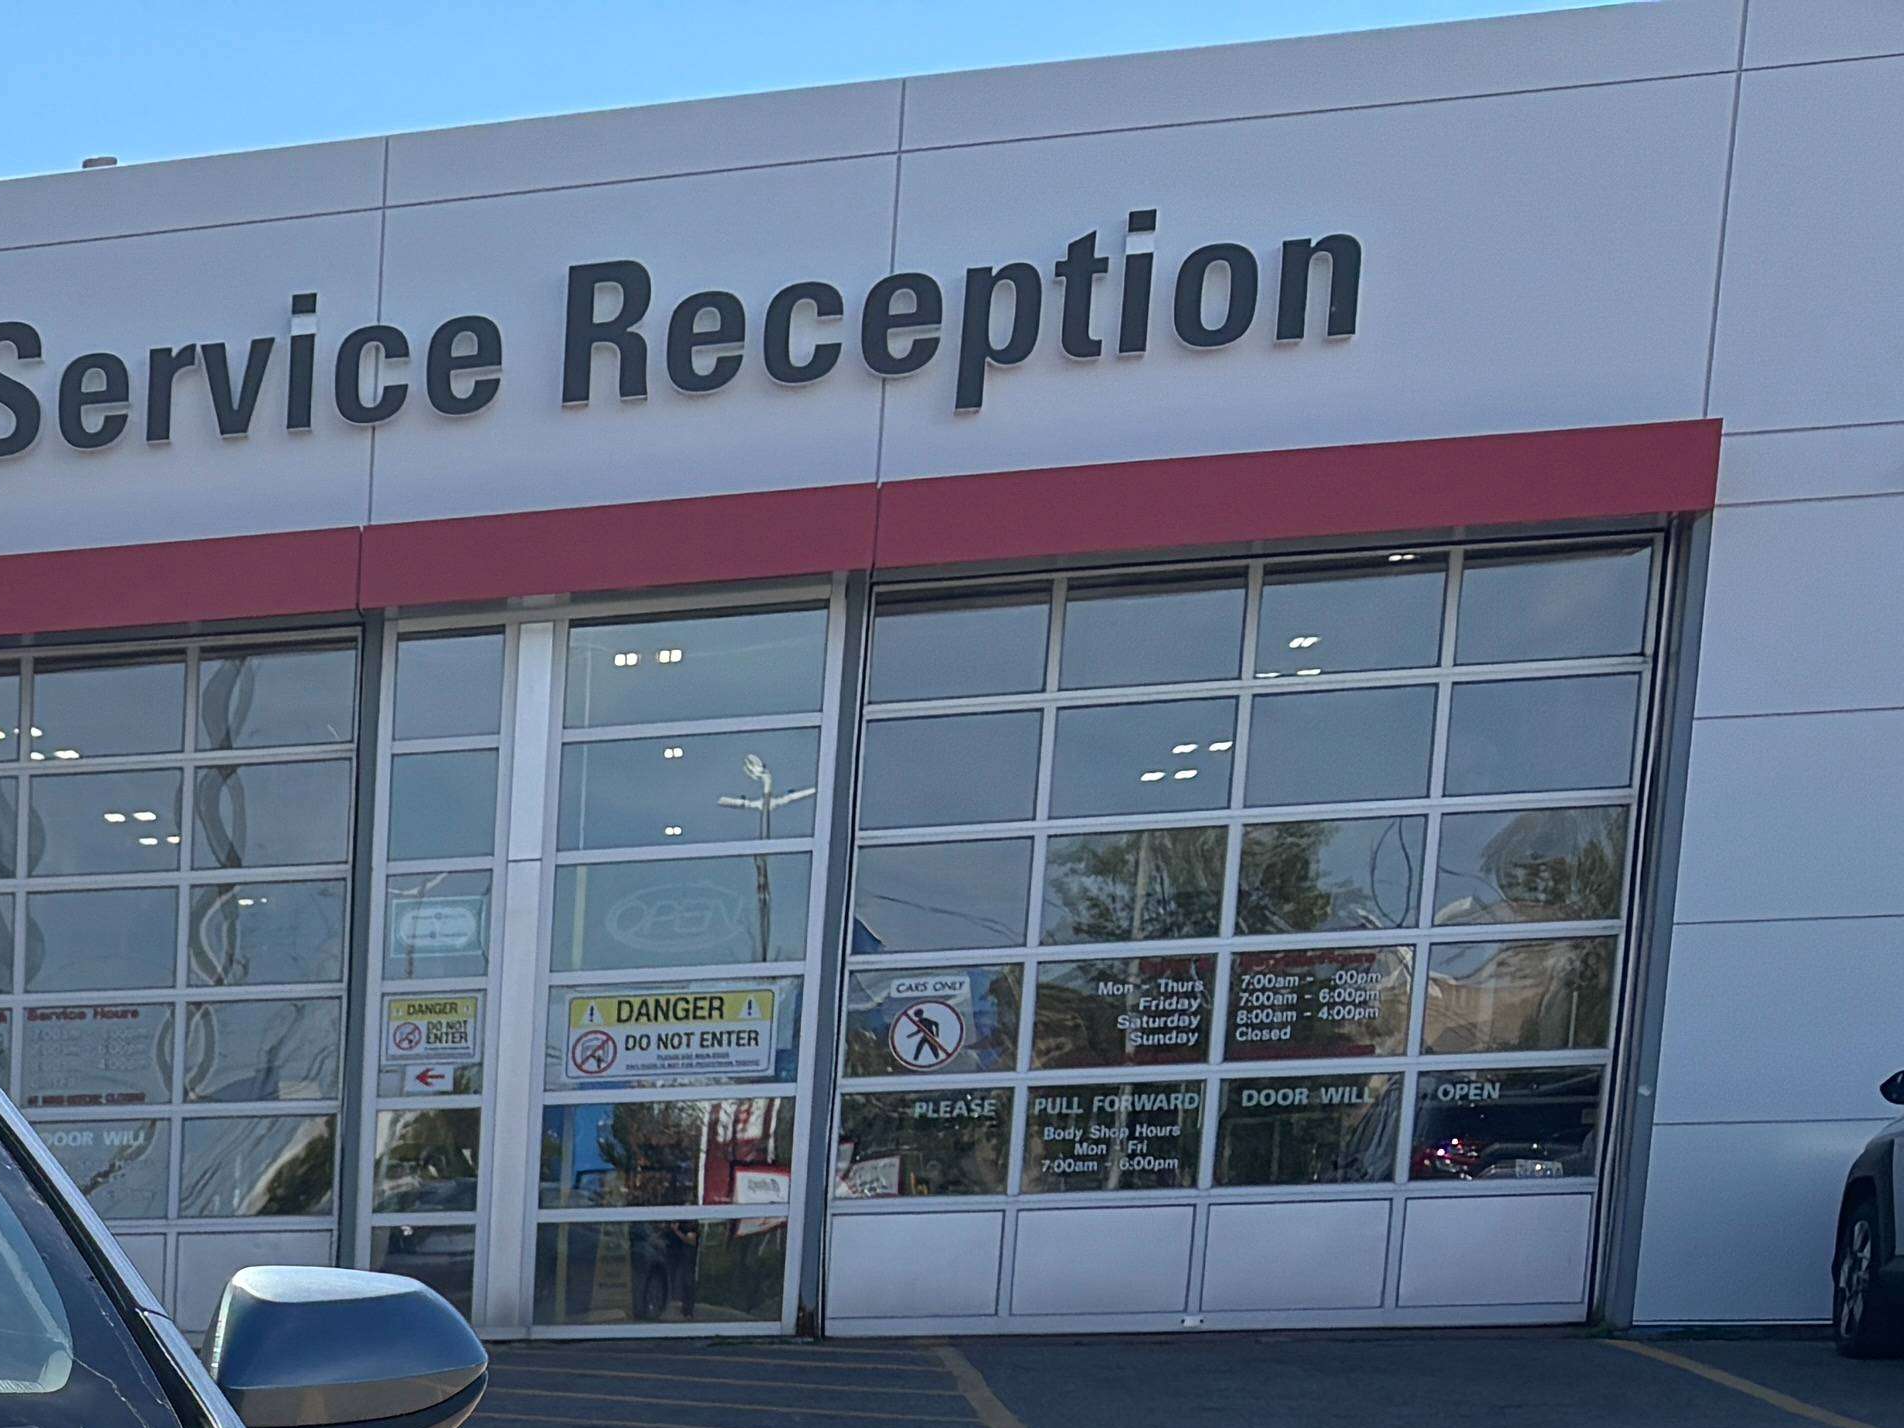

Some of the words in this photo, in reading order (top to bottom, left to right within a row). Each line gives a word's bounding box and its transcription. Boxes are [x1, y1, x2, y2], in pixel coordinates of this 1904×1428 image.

[561, 209, 1362, 412] Reception
[896, 981, 928, 993] CARS
[932, 980, 965, 992] ONLY
[1097, 981, 1134, 996] Mon
[1157, 978, 1204, 993] Thurs
[1240, 973, 1299, 989] 7:00am
[407, 1002, 458, 1016] DANGER
[616, 996, 725, 1023] DANGER
[1139, 995, 1201, 1013] Friday
[1238, 990, 1297, 1006] 7:00am
[1318, 987, 1381, 1004] 6:00pm
[93, 1006, 140, 1020] Hours
[1117, 1013, 1201, 1030] Saturday
[1236, 1008, 1296, 1024] 8:00am
[1317, 1005, 1380, 1021] 4:00pm
[426, 1020, 443, 1032] DO
[446, 1019, 468, 1031] NOT
[426, 1031, 468, 1044] ENTER
[624, 1033, 651, 1051] DO
[656, 1031, 696, 1050] NOT
[699, 1029, 760, 1048] ENTER
[1130, 1030, 1199, 1047] Sunday
[1236, 1026, 1292, 1041] Closed
[913, 1099, 997, 1119] PLEASE
[1033, 1097, 1083, 1115] PULL
[1092, 1092, 1200, 1113] FORWARD
[1241, 1087, 1309, 1108] DOOR
[1320, 1086, 1376, 1106] WILL
[1437, 1082, 1502, 1102] OPEN
[1043, 1125, 1083, 1142] Body
[1090, 1124, 1129, 1141] Shop
[1134, 1123, 1182, 1138] Hours
[1074, 1142, 1107, 1156] Mon
[1127, 1140, 1148, 1154] Fri
[1041, 1158, 1098, 1173] 7:00am
[1119, 1156, 1179, 1174] 6:00pm
